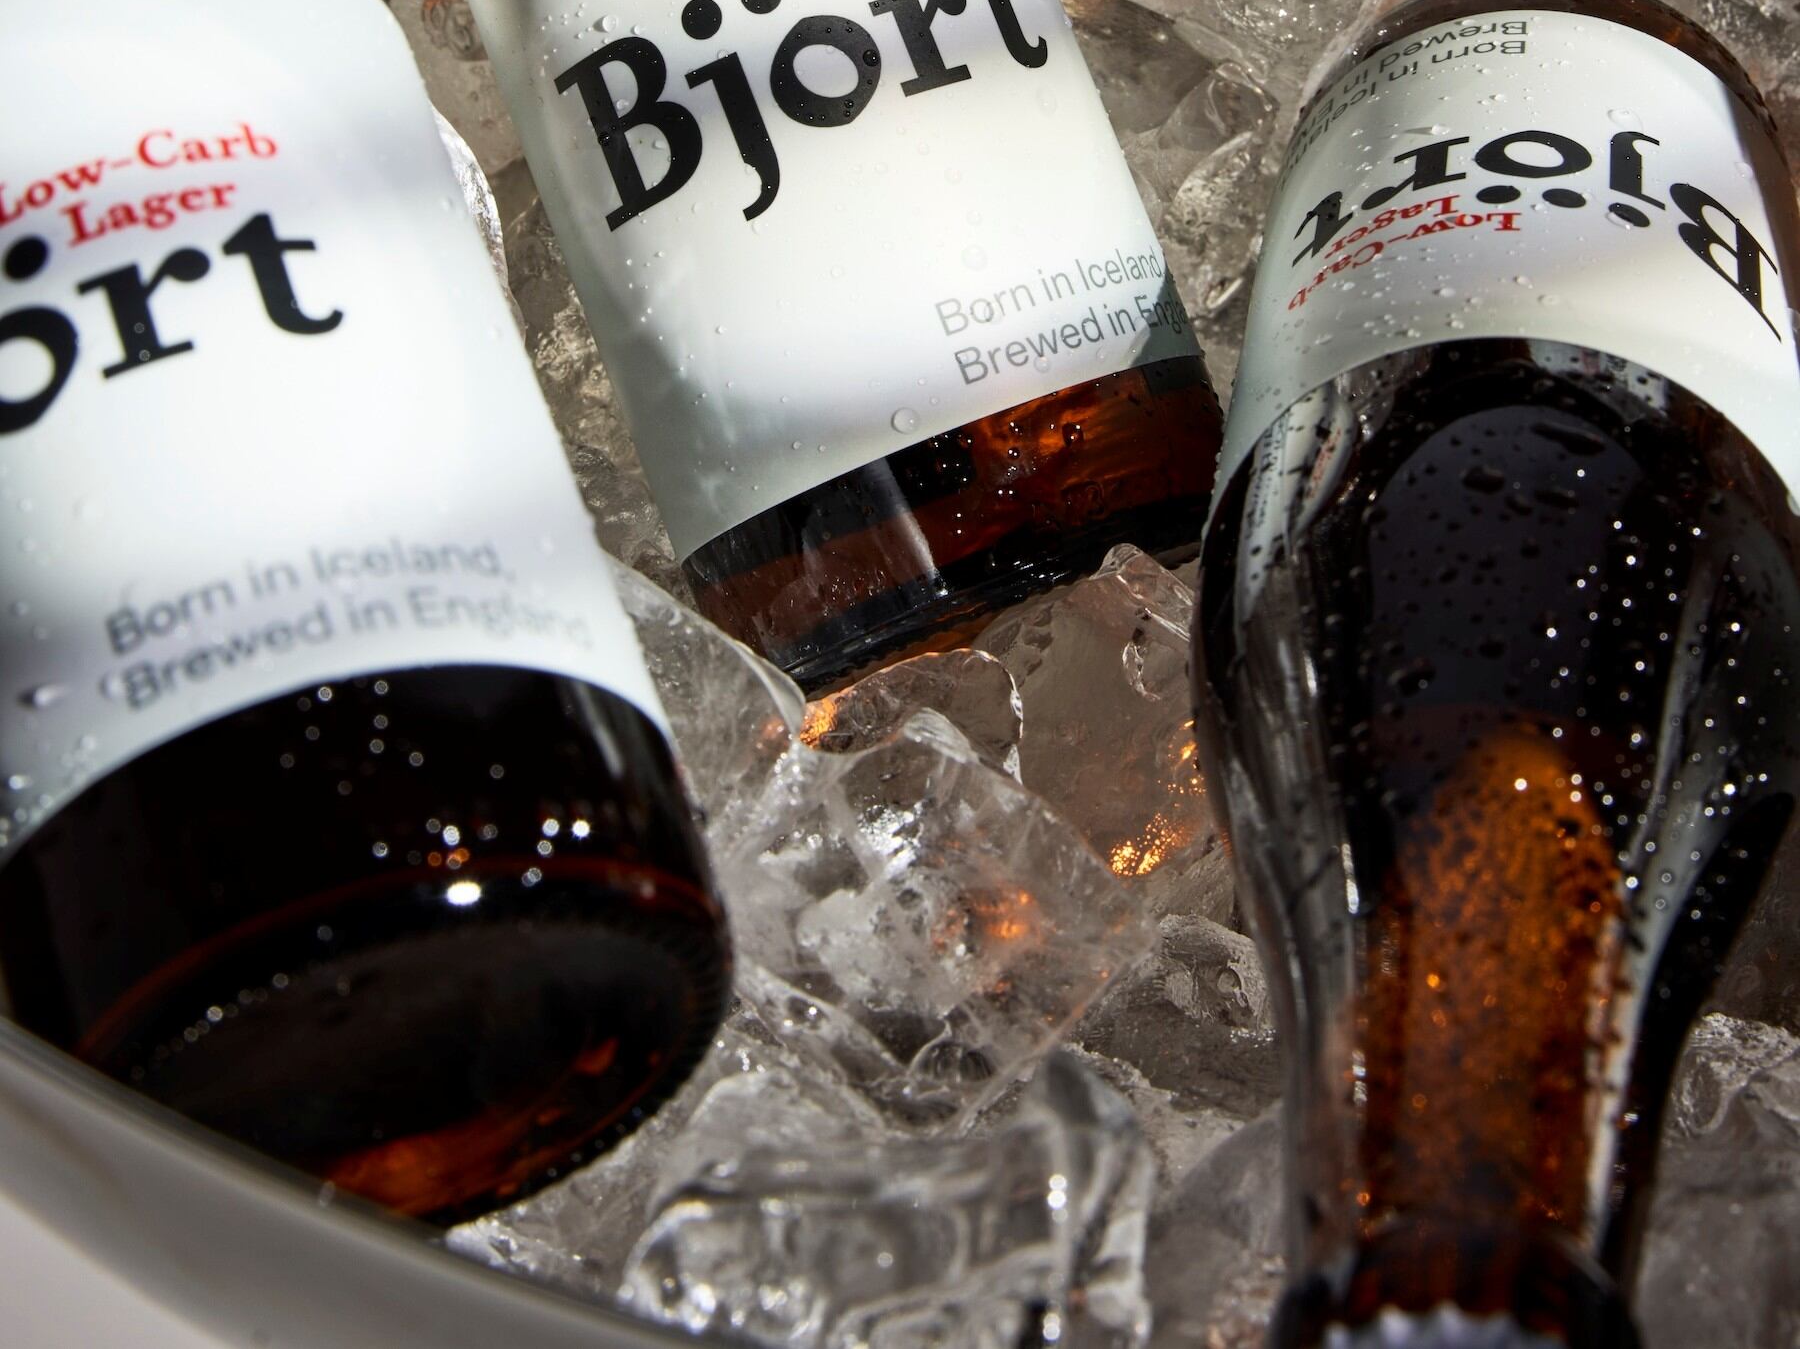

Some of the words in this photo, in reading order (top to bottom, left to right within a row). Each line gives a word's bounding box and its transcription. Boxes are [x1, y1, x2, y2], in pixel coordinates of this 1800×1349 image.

[1343, 68, 1369, 94] in
[1379, 21, 1527, 74] Brewed
[1389, 60, 1418, 81] in
[1432, 40, 1526, 64] Born
[61, 183, 236, 248] Lager
[1292, 130, 1782, 344] Björt
[1324, 194, 1461, 259] Lager
[1287, 212, 1522, 311] Low-Carb
[0, 211, 344, 436] ört
[935, 282, 1036, 336] Born
[1037, 268, 1075, 302] in
[954, 306, 1105, 385] Brewed
[1103, 303, 1137, 337] in
[104, 580, 235, 658] Born
[247, 558, 300, 601] in
[122, 599, 334, 710] Brewed
[348, 592, 396, 634] in
